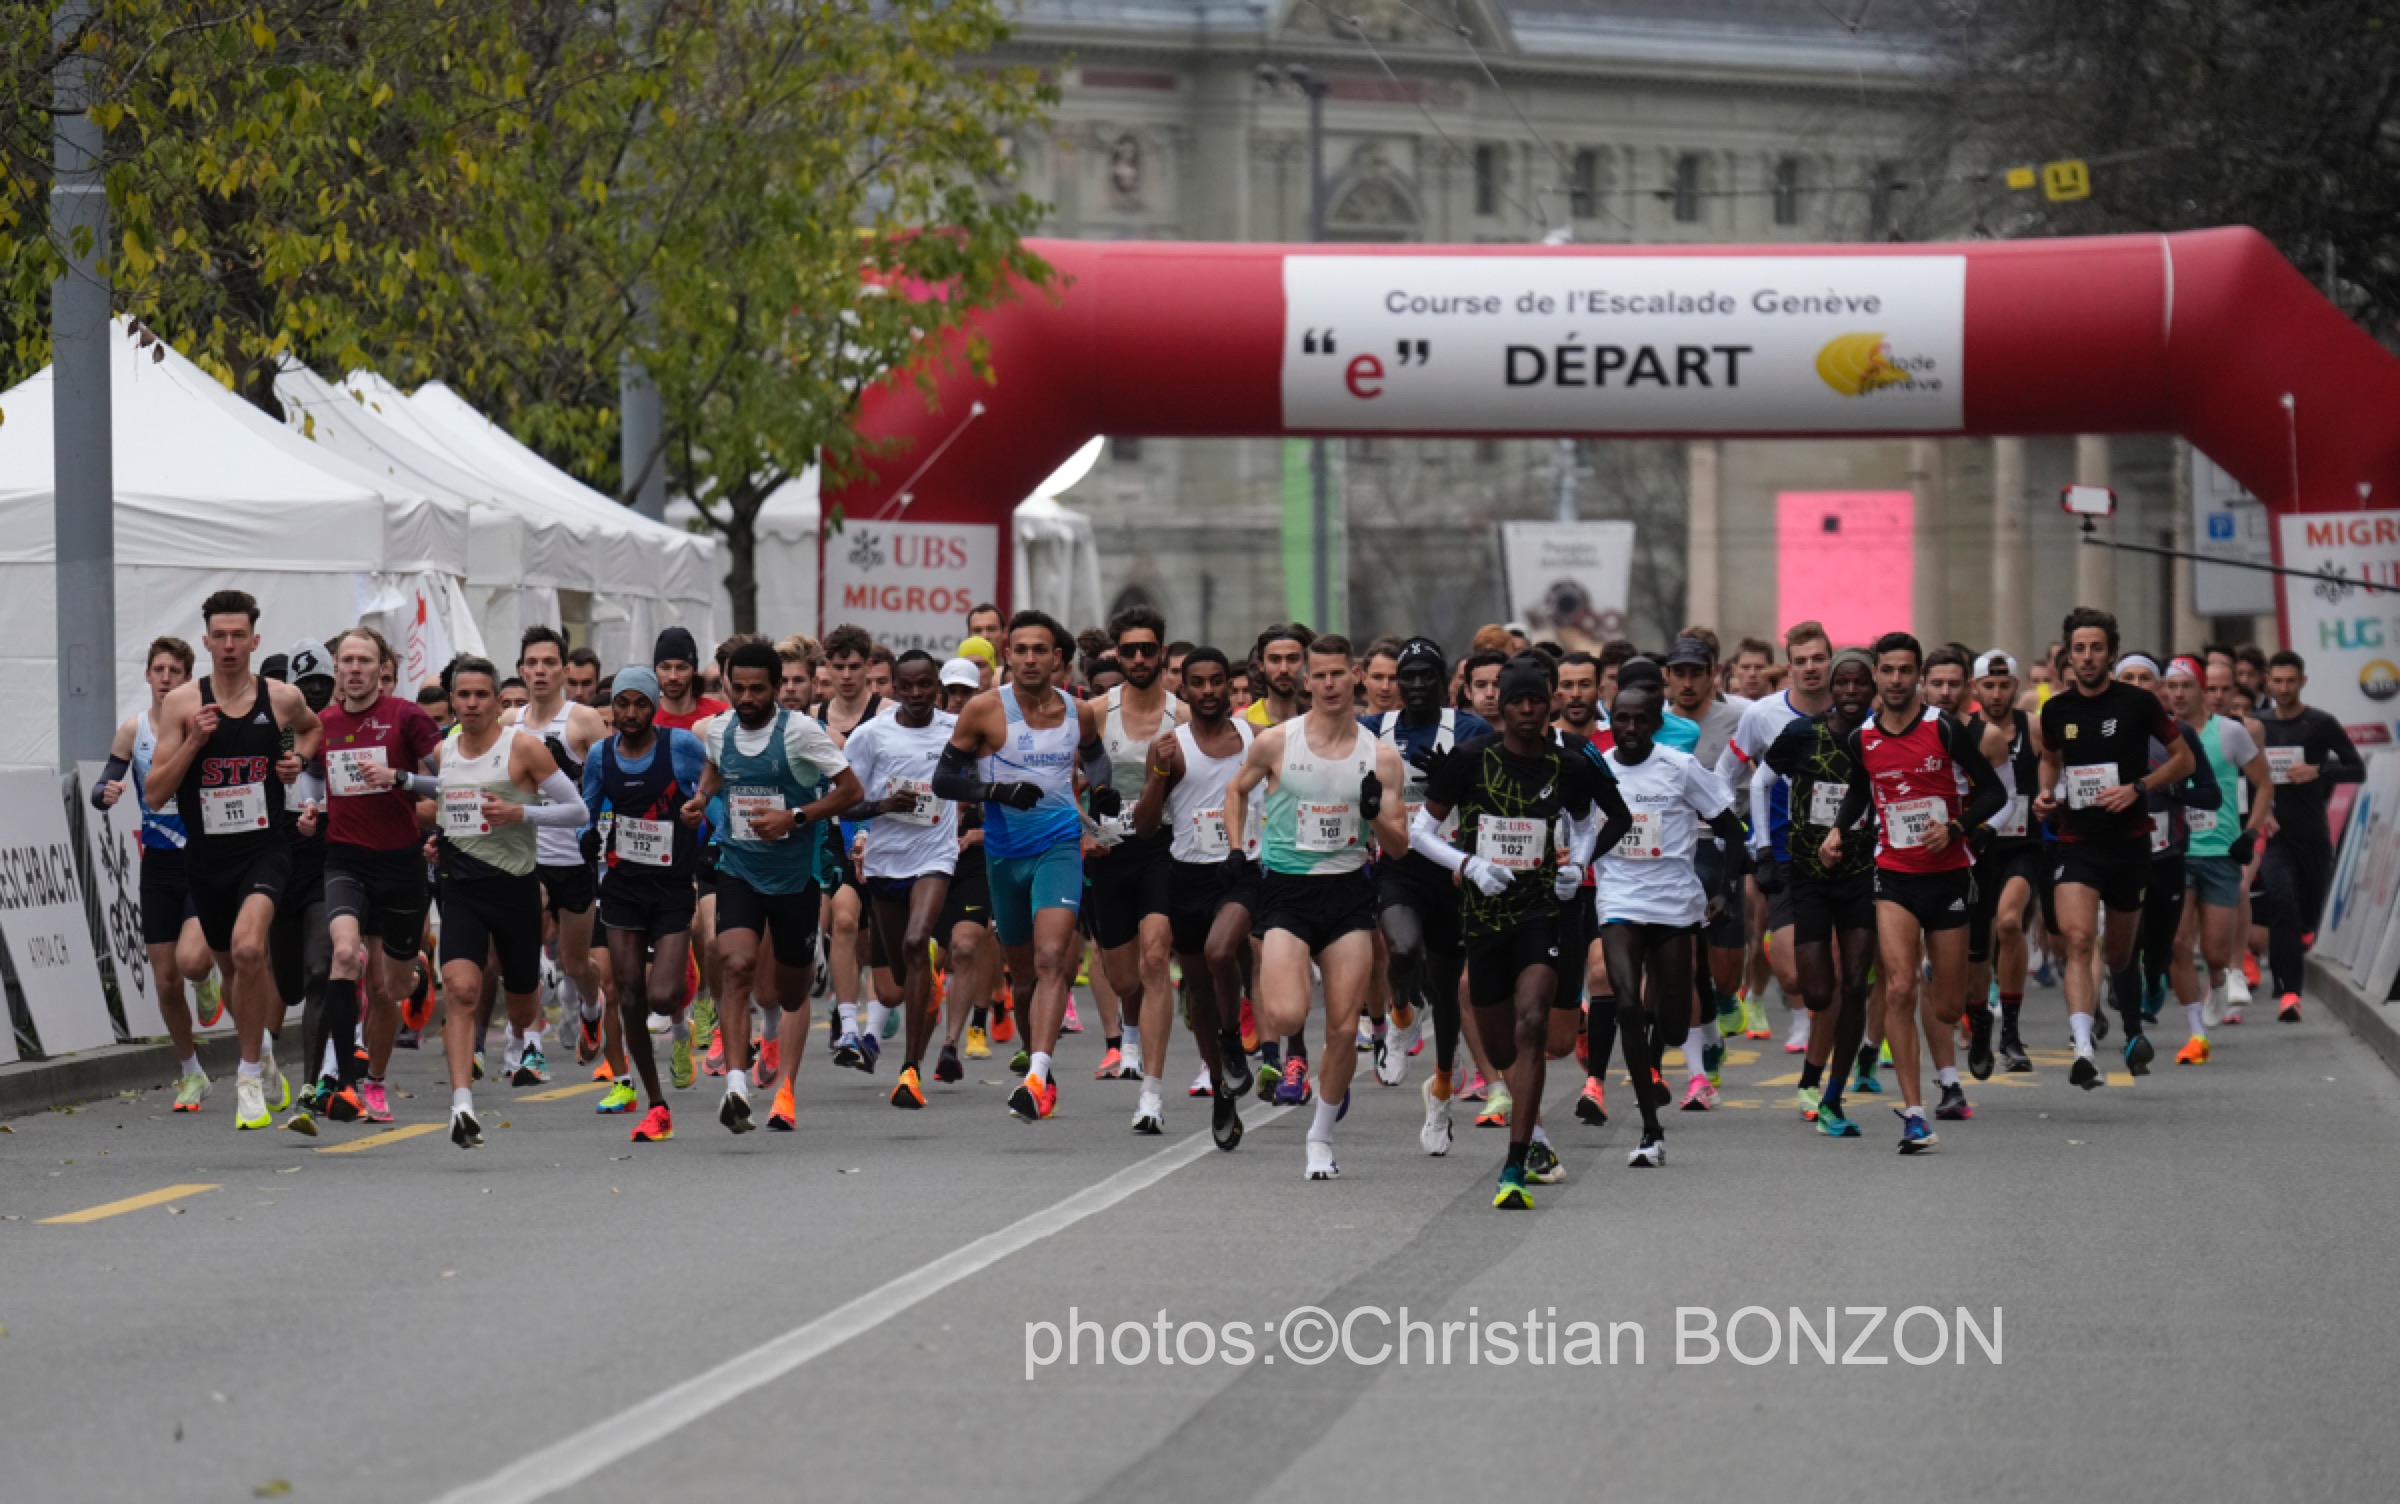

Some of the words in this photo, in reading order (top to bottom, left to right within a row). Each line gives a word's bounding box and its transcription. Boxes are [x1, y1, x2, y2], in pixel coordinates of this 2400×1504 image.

[1385, 289, 1501, 313] Course
[1516, 290, 1555, 313] de
[1567, 289, 1736, 313] l'Escalade
[1752, 289, 1881, 314] Genève
[1504, 331, 1753, 388] DÉPART
[2306, 517, 2400, 548] MIGR
[893, 534, 968, 570] UBS
[2362, 559, 2400, 598] U
[844, 583, 973, 615] MIGROS
[2320, 616, 2384, 651] HUG
[212, 785, 253, 799] MIGROS
[225, 809, 245, 821] 111
[1311, 804, 1349, 814] MIGROS
[1895, 800, 1933, 813] MIGROS
[1509, 821, 1533, 832] UBS
[632, 841, 652, 853] 112
[1500, 844, 1523, 856] 102
[0, 842, 79, 911] ESCHBACH
